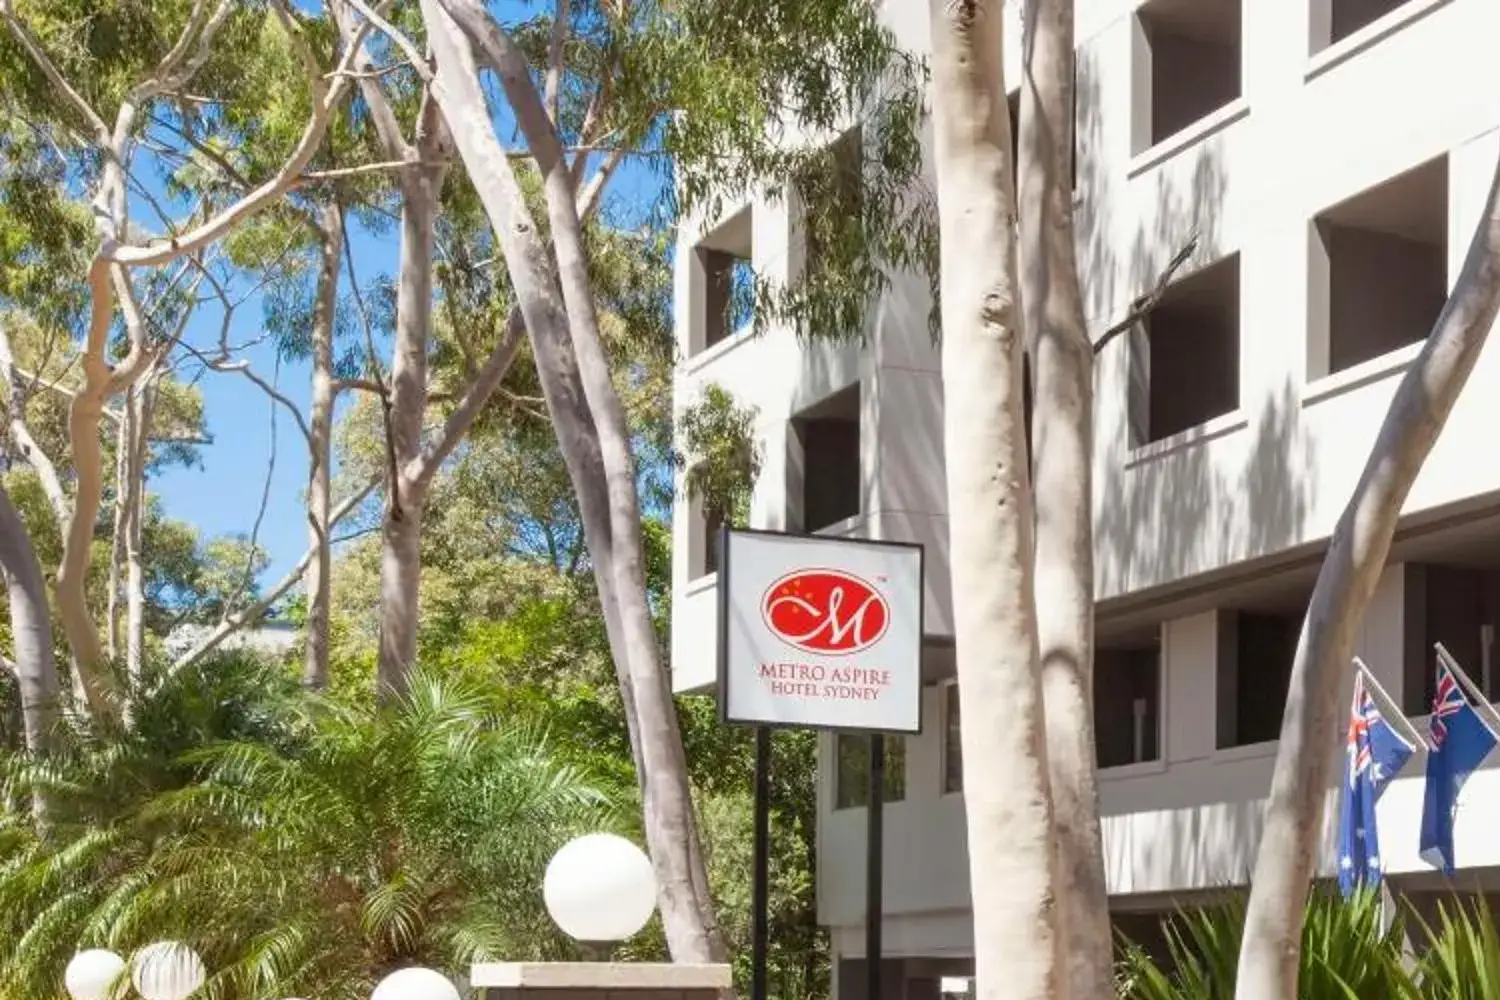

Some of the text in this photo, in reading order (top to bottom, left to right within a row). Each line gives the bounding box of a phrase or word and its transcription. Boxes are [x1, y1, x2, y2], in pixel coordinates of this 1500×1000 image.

[760, 663, 891, 685] METRO ASPIRE
[771, 681, 880, 700] HOTEL SYDNEY
